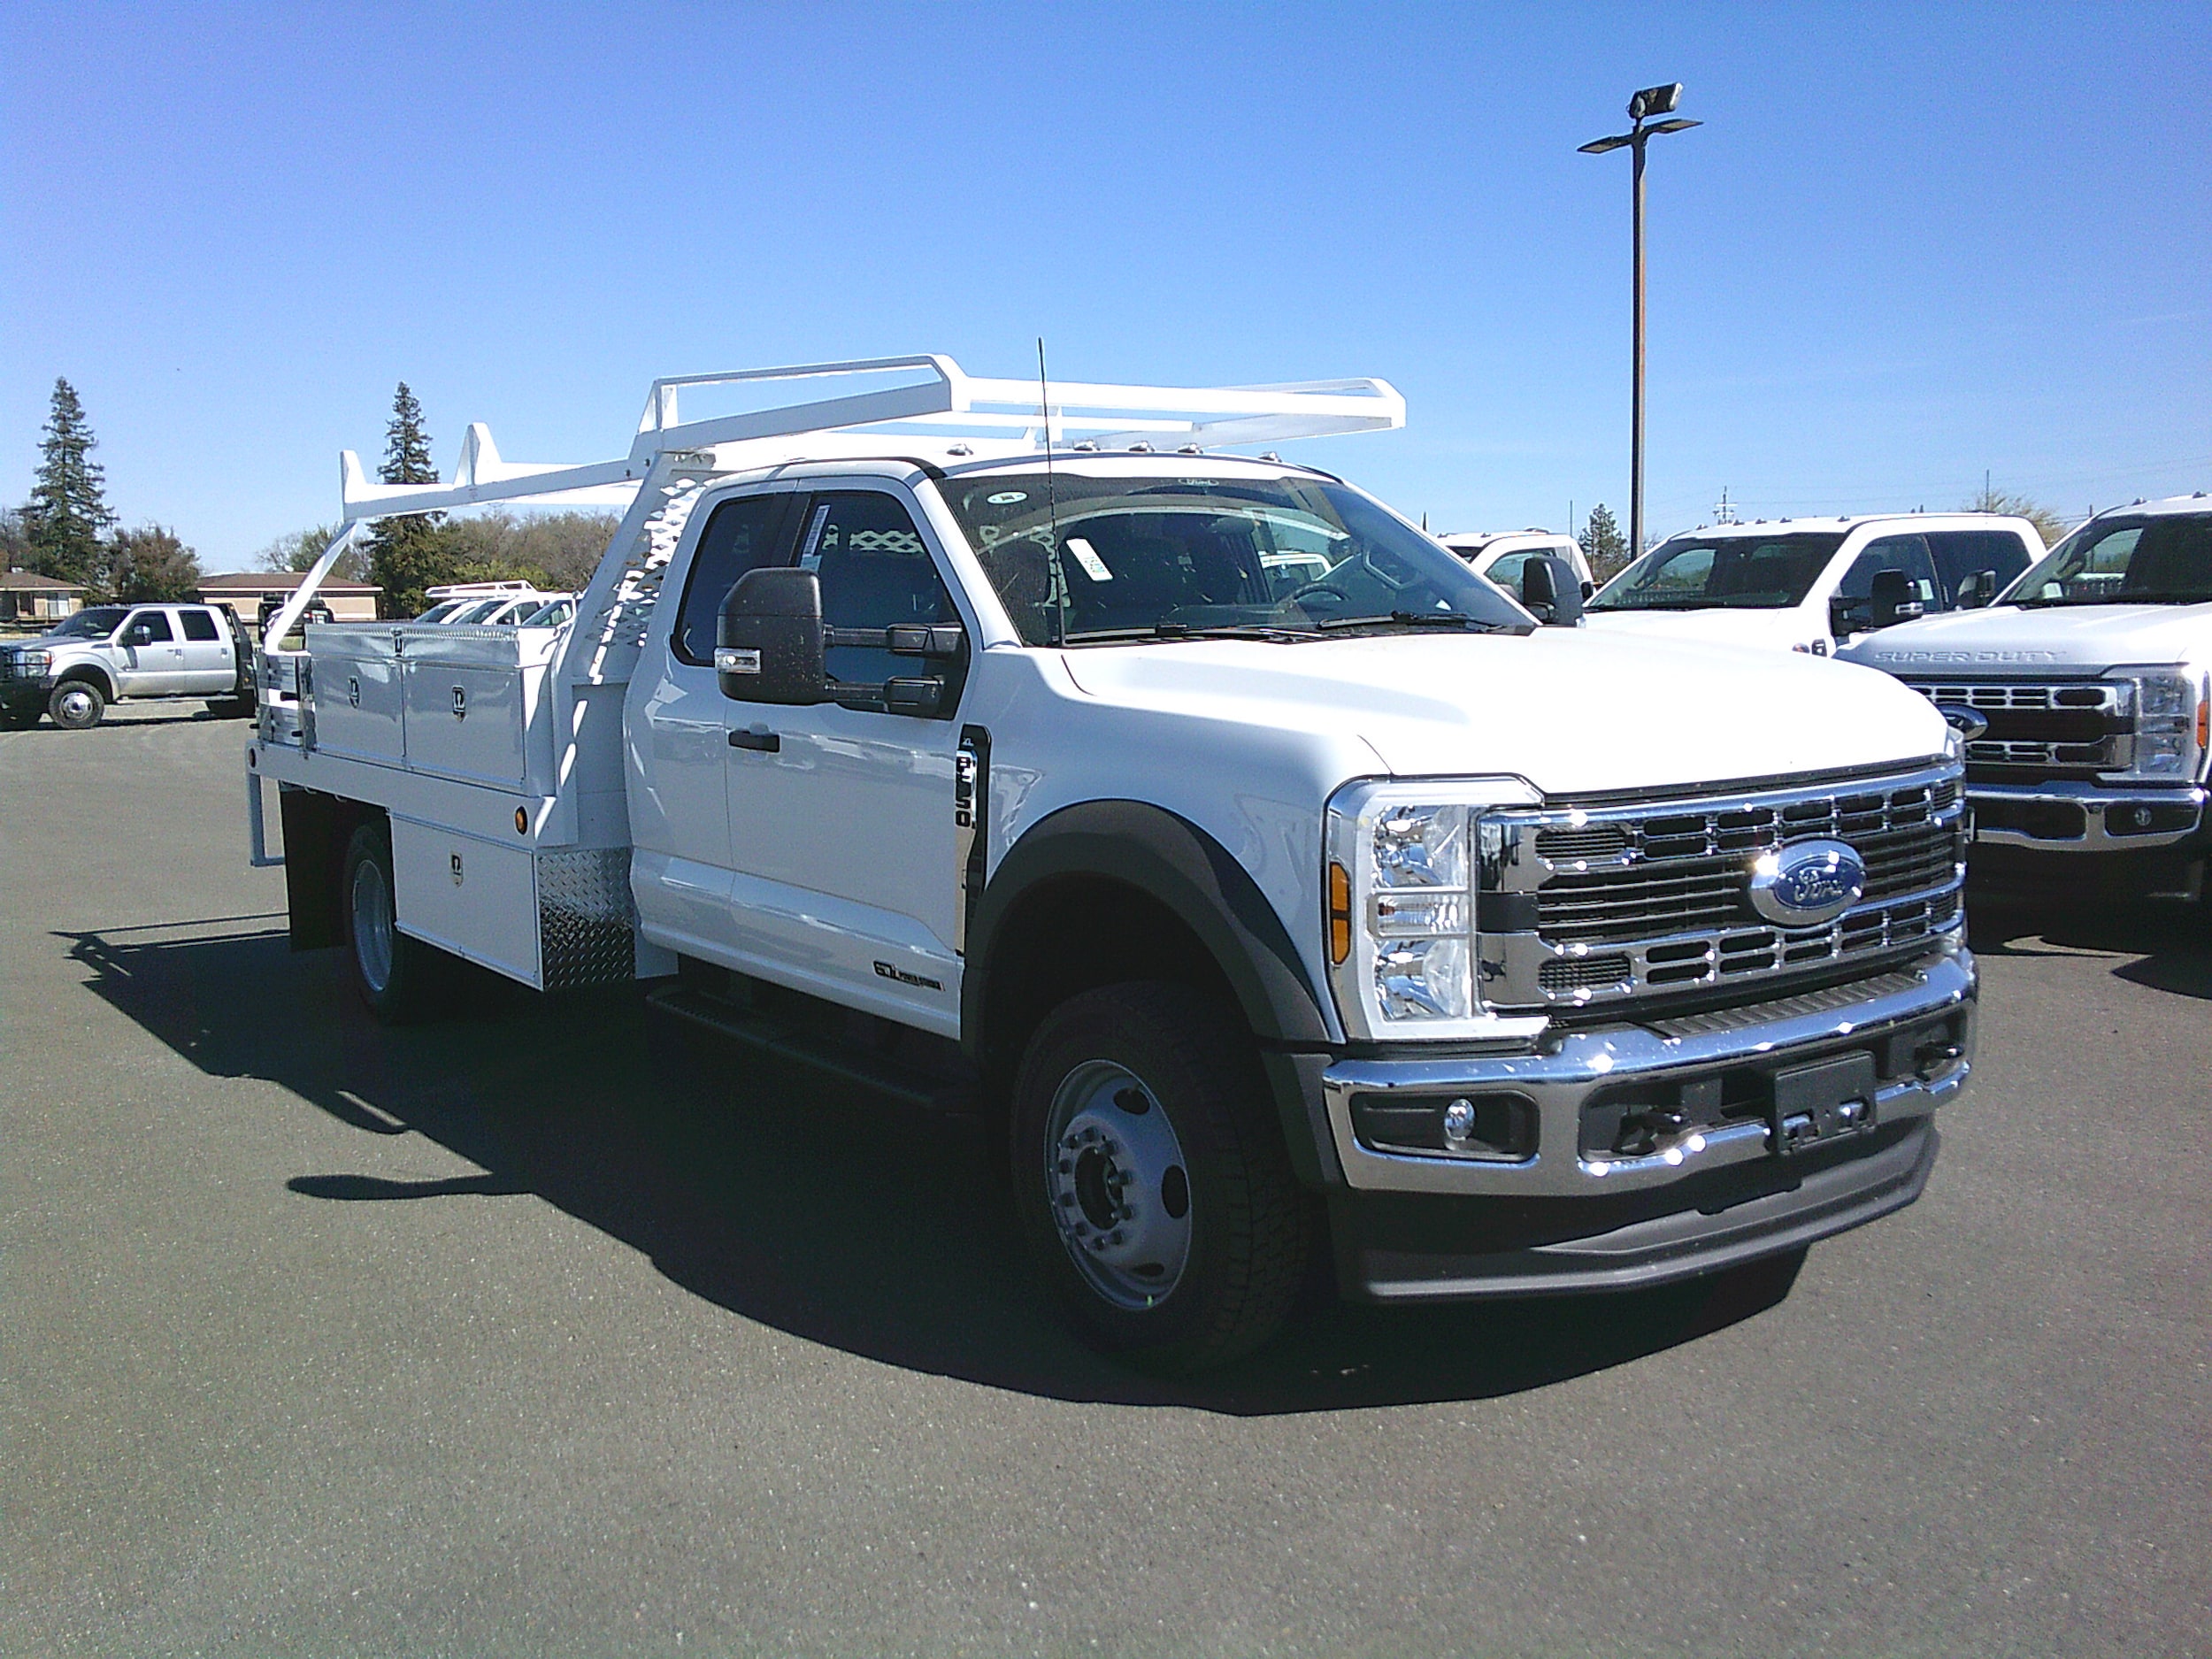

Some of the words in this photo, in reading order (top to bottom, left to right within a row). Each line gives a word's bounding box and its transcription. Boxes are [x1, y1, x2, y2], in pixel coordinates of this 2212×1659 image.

[1873, 650, 1970, 663] SUPER
[1974, 650, 2067, 663] DUTY
[1793, 866, 1845, 902] Ford
